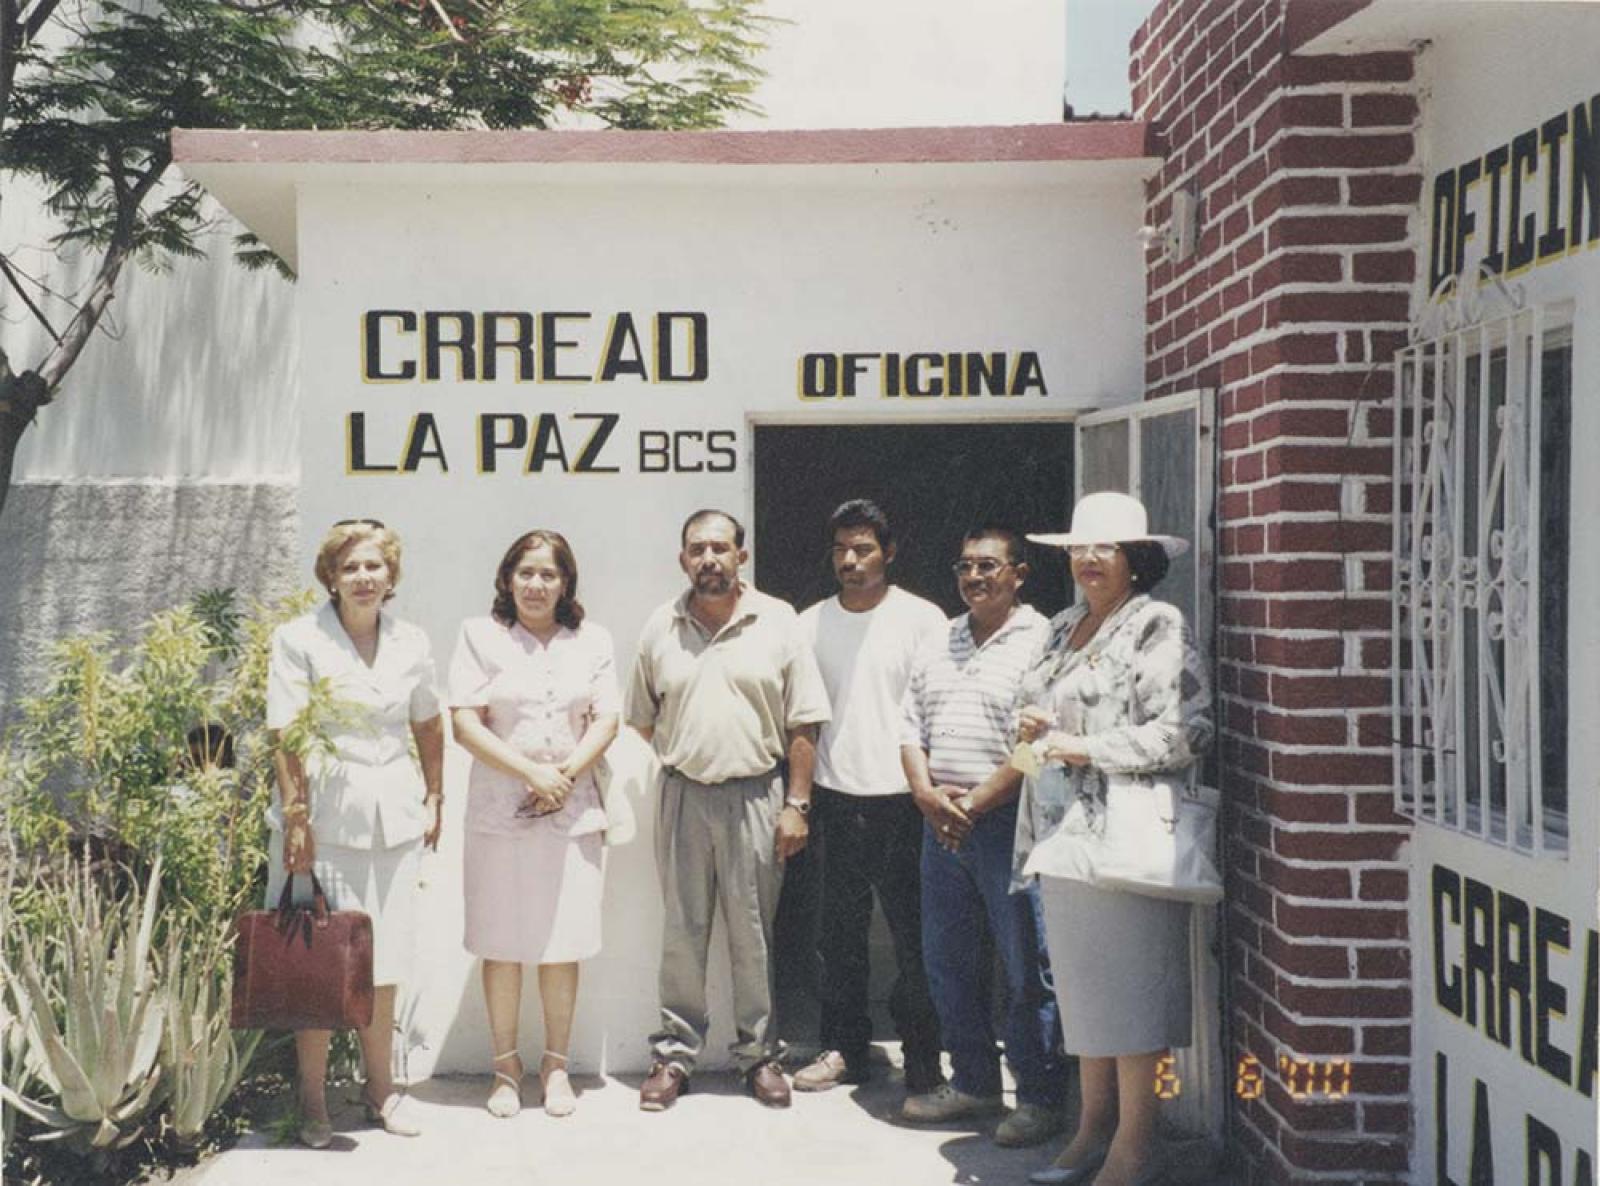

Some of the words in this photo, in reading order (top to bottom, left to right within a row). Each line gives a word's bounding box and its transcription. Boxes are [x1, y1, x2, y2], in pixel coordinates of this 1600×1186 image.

[1428, 92, 1600, 305] OFICIN
[361, 309, 709, 384] CRREAD
[797, 351, 1048, 400] OFICINA
[346, 411, 449, 475] LA
[476, 412, 621, 475] PAZ
[639, 430, 737, 474] BCS
